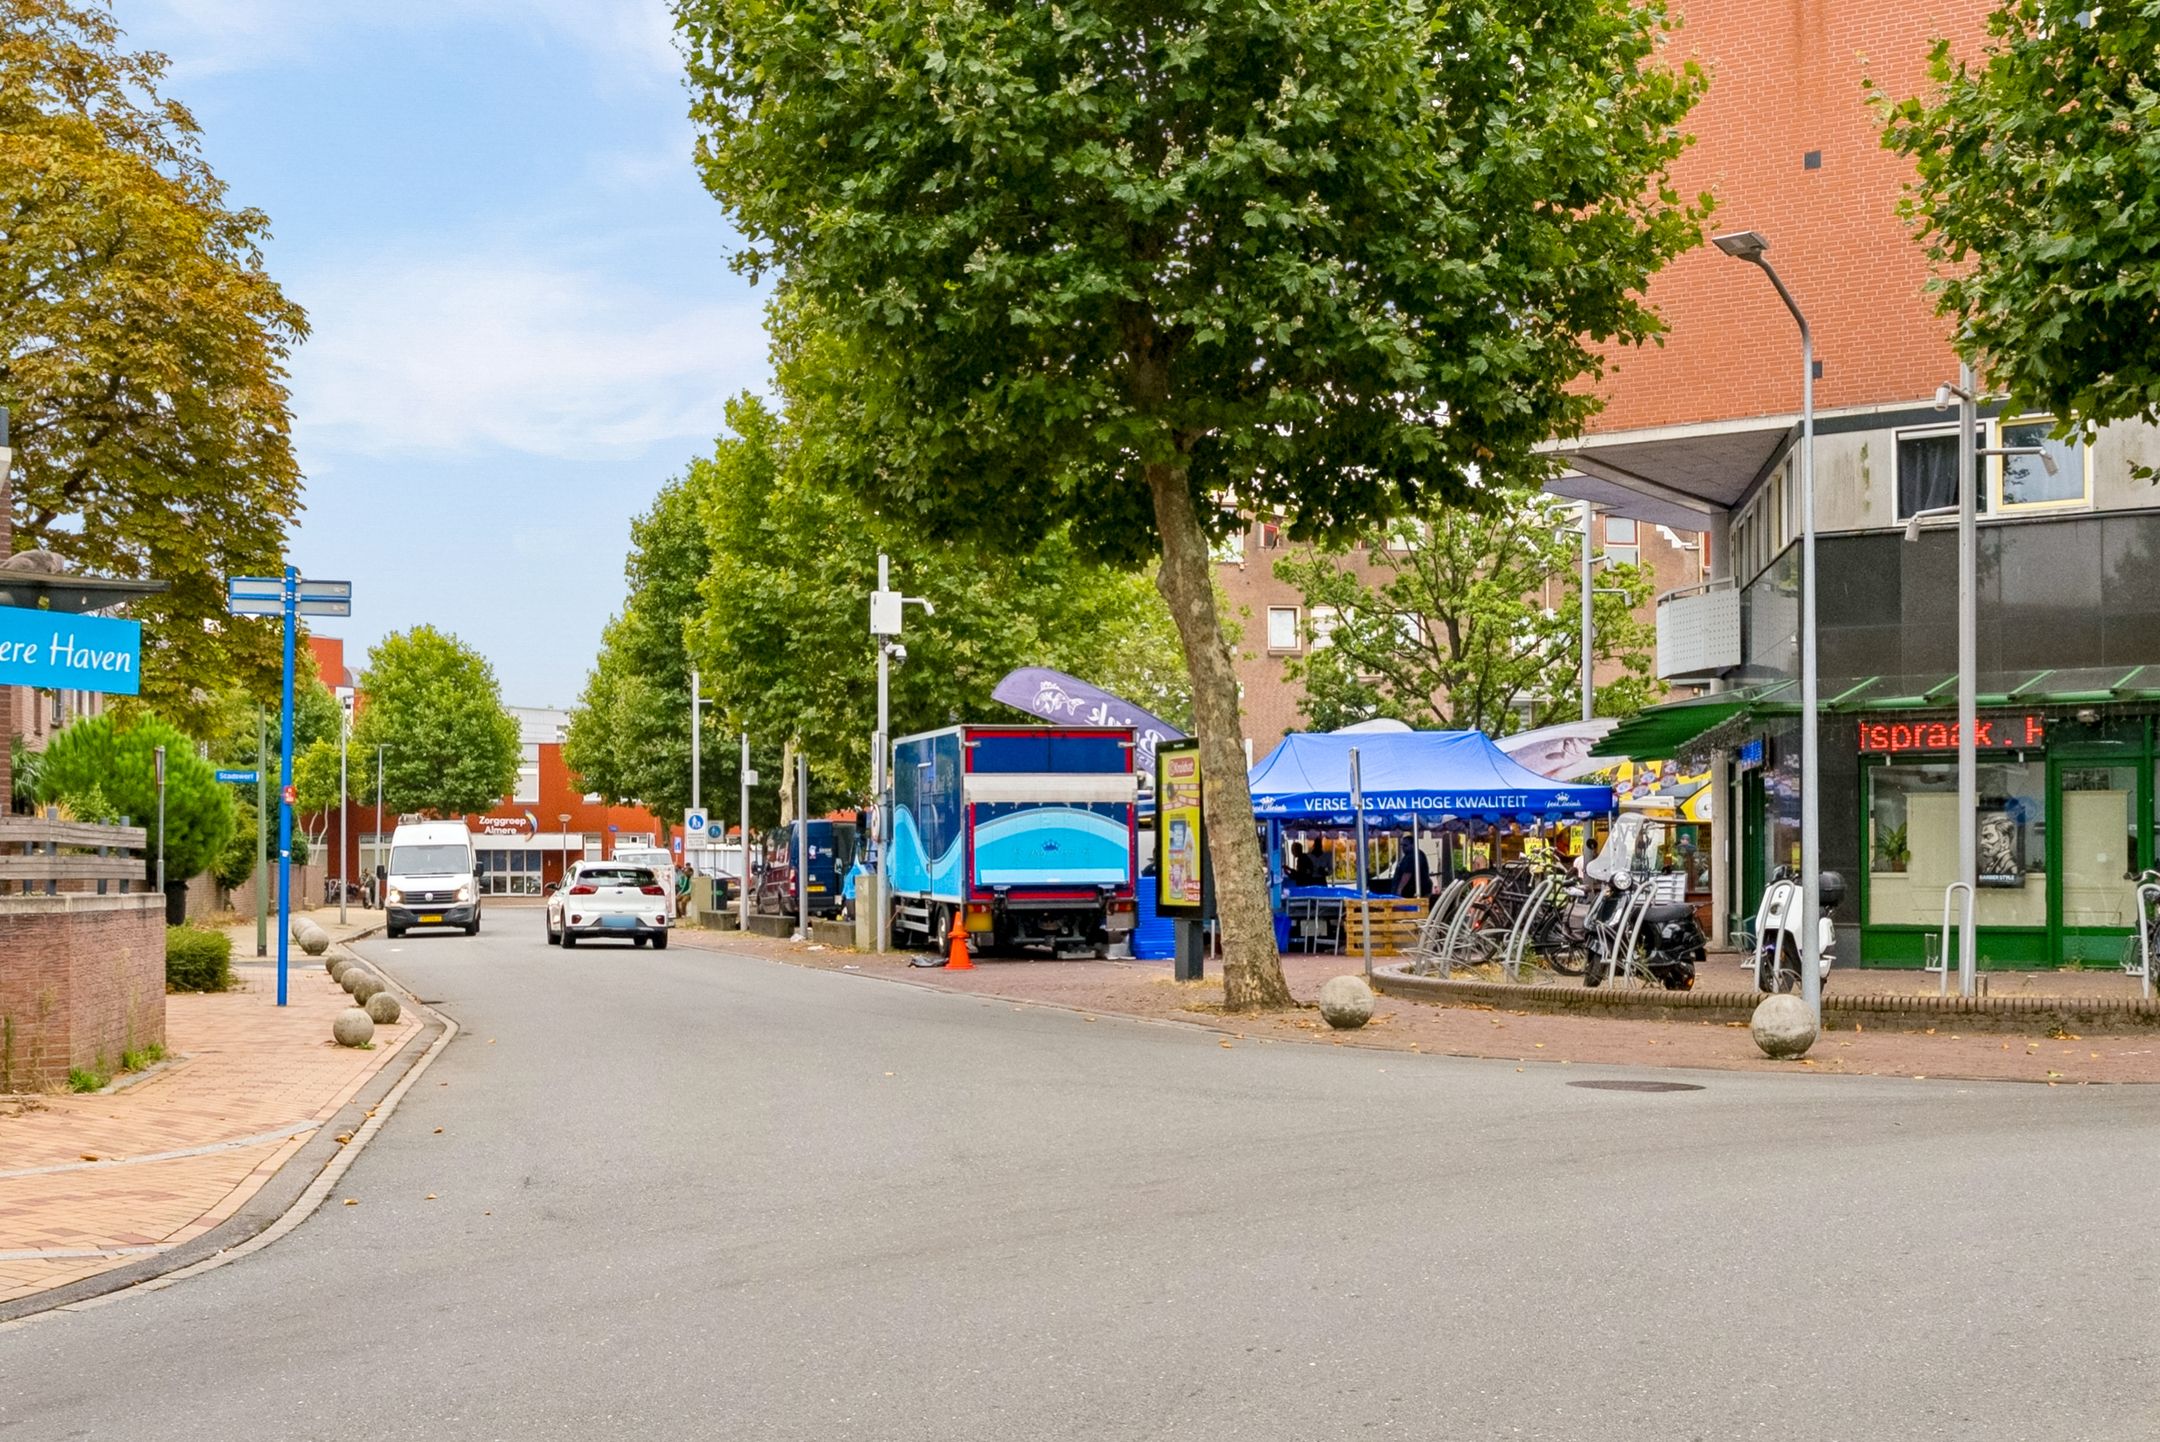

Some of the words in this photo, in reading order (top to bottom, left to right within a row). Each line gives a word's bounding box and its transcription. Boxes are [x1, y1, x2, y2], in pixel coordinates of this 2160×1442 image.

[49, 631, 132, 673] Haven
[1304, 797, 1348, 811] VERSE
[1377, 796, 1407, 810] VAN
[1411, 796, 1451, 809] HOGE
[1455, 794, 1528, 808] KWALITEIT
[479, 816, 526, 826] Zorggroep
[484, 826, 517, 834] Almere
